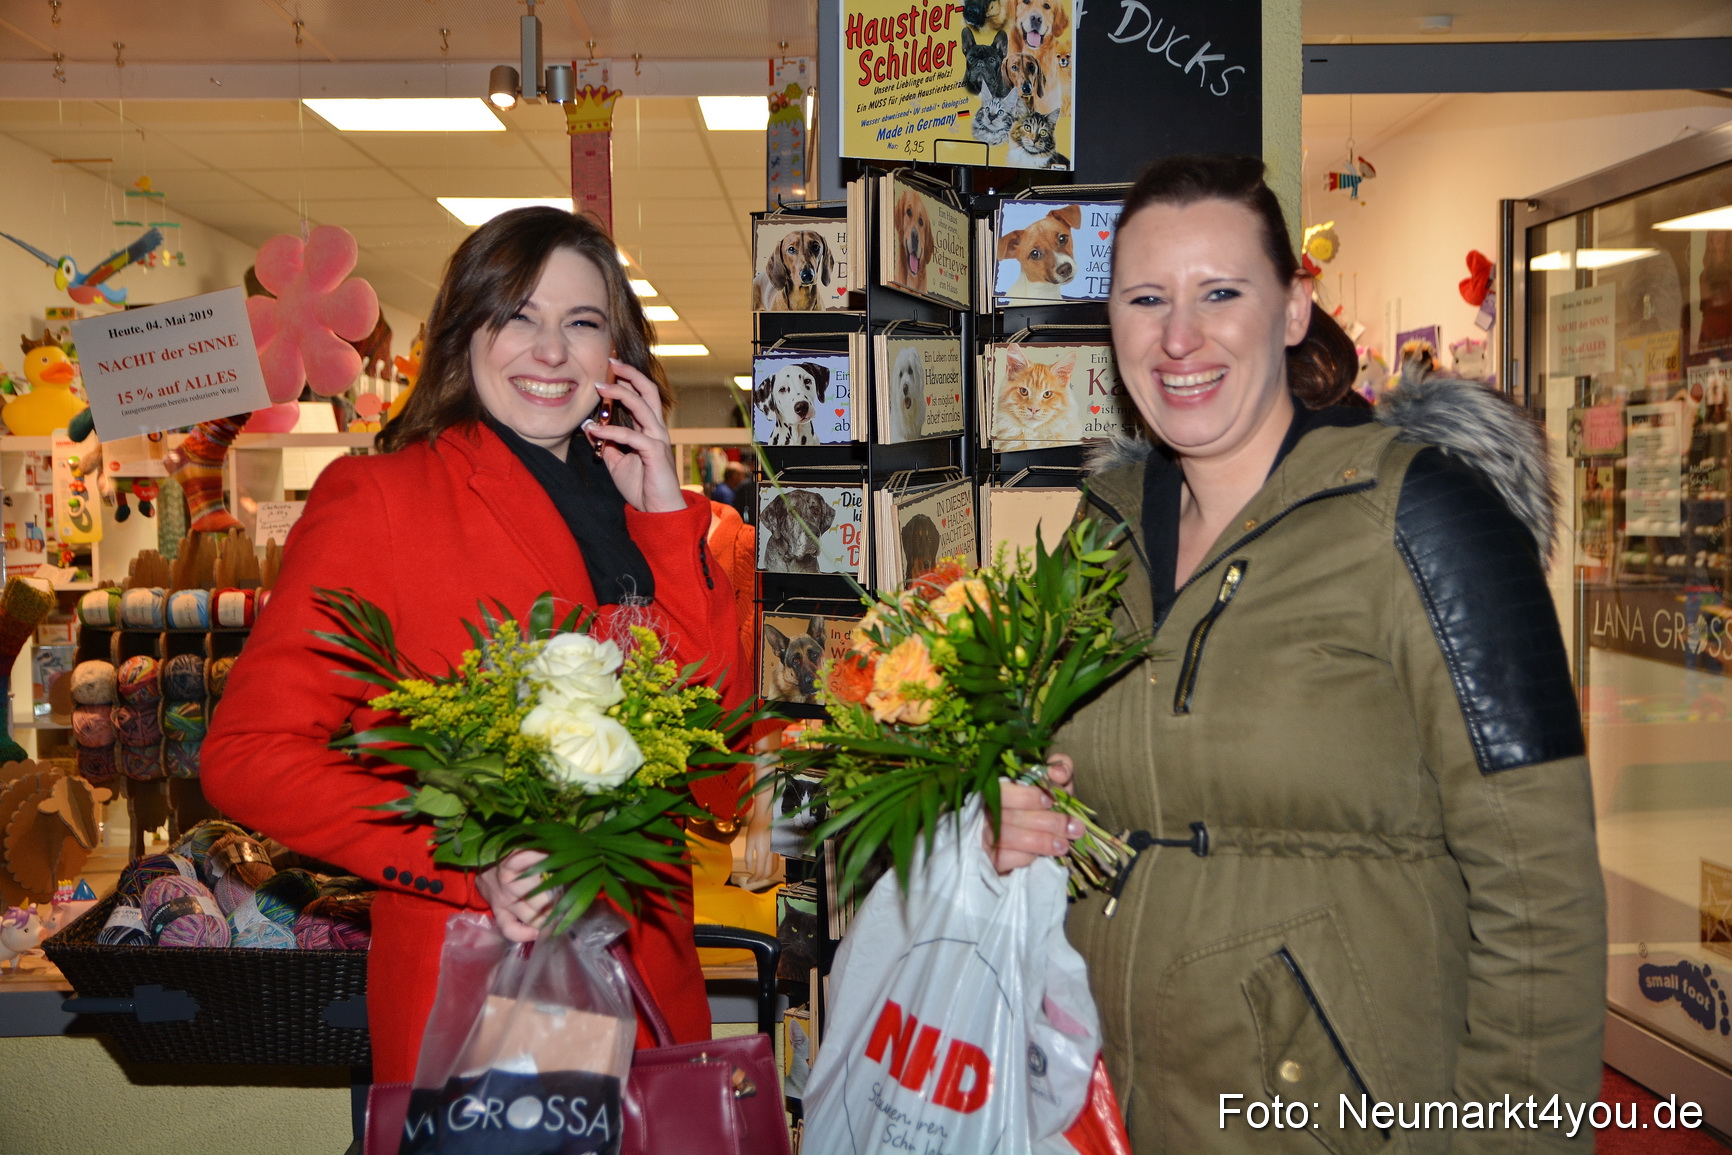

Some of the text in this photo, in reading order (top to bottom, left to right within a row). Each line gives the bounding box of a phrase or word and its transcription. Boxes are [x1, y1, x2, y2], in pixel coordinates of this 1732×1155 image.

[845, 0, 965, 50] Haustier-
[858, 35, 957, 86] Schilder
[1108, 0, 1245, 96] DUCKS
[874, 69, 953, 96] Unsere Lieblinge auf Holz!
[856, 104, 867, 113] Ein
[868, 98, 887, 110] MUSS
[888, 96, 898, 106] für
[899, 93, 917, 105] jeden
[861, 96, 969, 127] Wasser abweisend UV stabil Ökologisch
[876, 113, 957, 142] Made in Germany
[938, 206, 958, 225] Ein Haus
[1090, 212, 1109, 227] IN
[936, 230, 965, 259] Golden
[932, 245, 967, 276] Retriever
[946, 281, 958, 295] Haus
[108, 308, 214, 339] Heute, 04. Mai 2019
[98, 333, 239, 375] NACHT der SINNE
[924, 350, 932, 363] Ein
[933, 350, 946, 363] Leben
[1091, 354, 1108, 364] Ein
[117, 369, 238, 406] 15 % auf ALLES
[925, 368, 959, 385] Havaneser
[121, 385, 240, 417] (ausgenommen bereits reduzierte Ware)
[1101, 403, 1114, 414] ist
[926, 406, 960, 425] aber sinnlos
[1085, 418, 1117, 432] aber
[841, 491, 862, 508] Die
[936, 489, 972, 517] IN DIESEM
[947, 510, 964, 529] HAUS
[940, 521, 974, 549] WACHT EIN
[831, 629, 841, 640] In
[1593, 600, 1646, 644] LANA
[1645, 974, 1711, 1011] small foot
[447, 1094, 610, 1142] GROSSA
